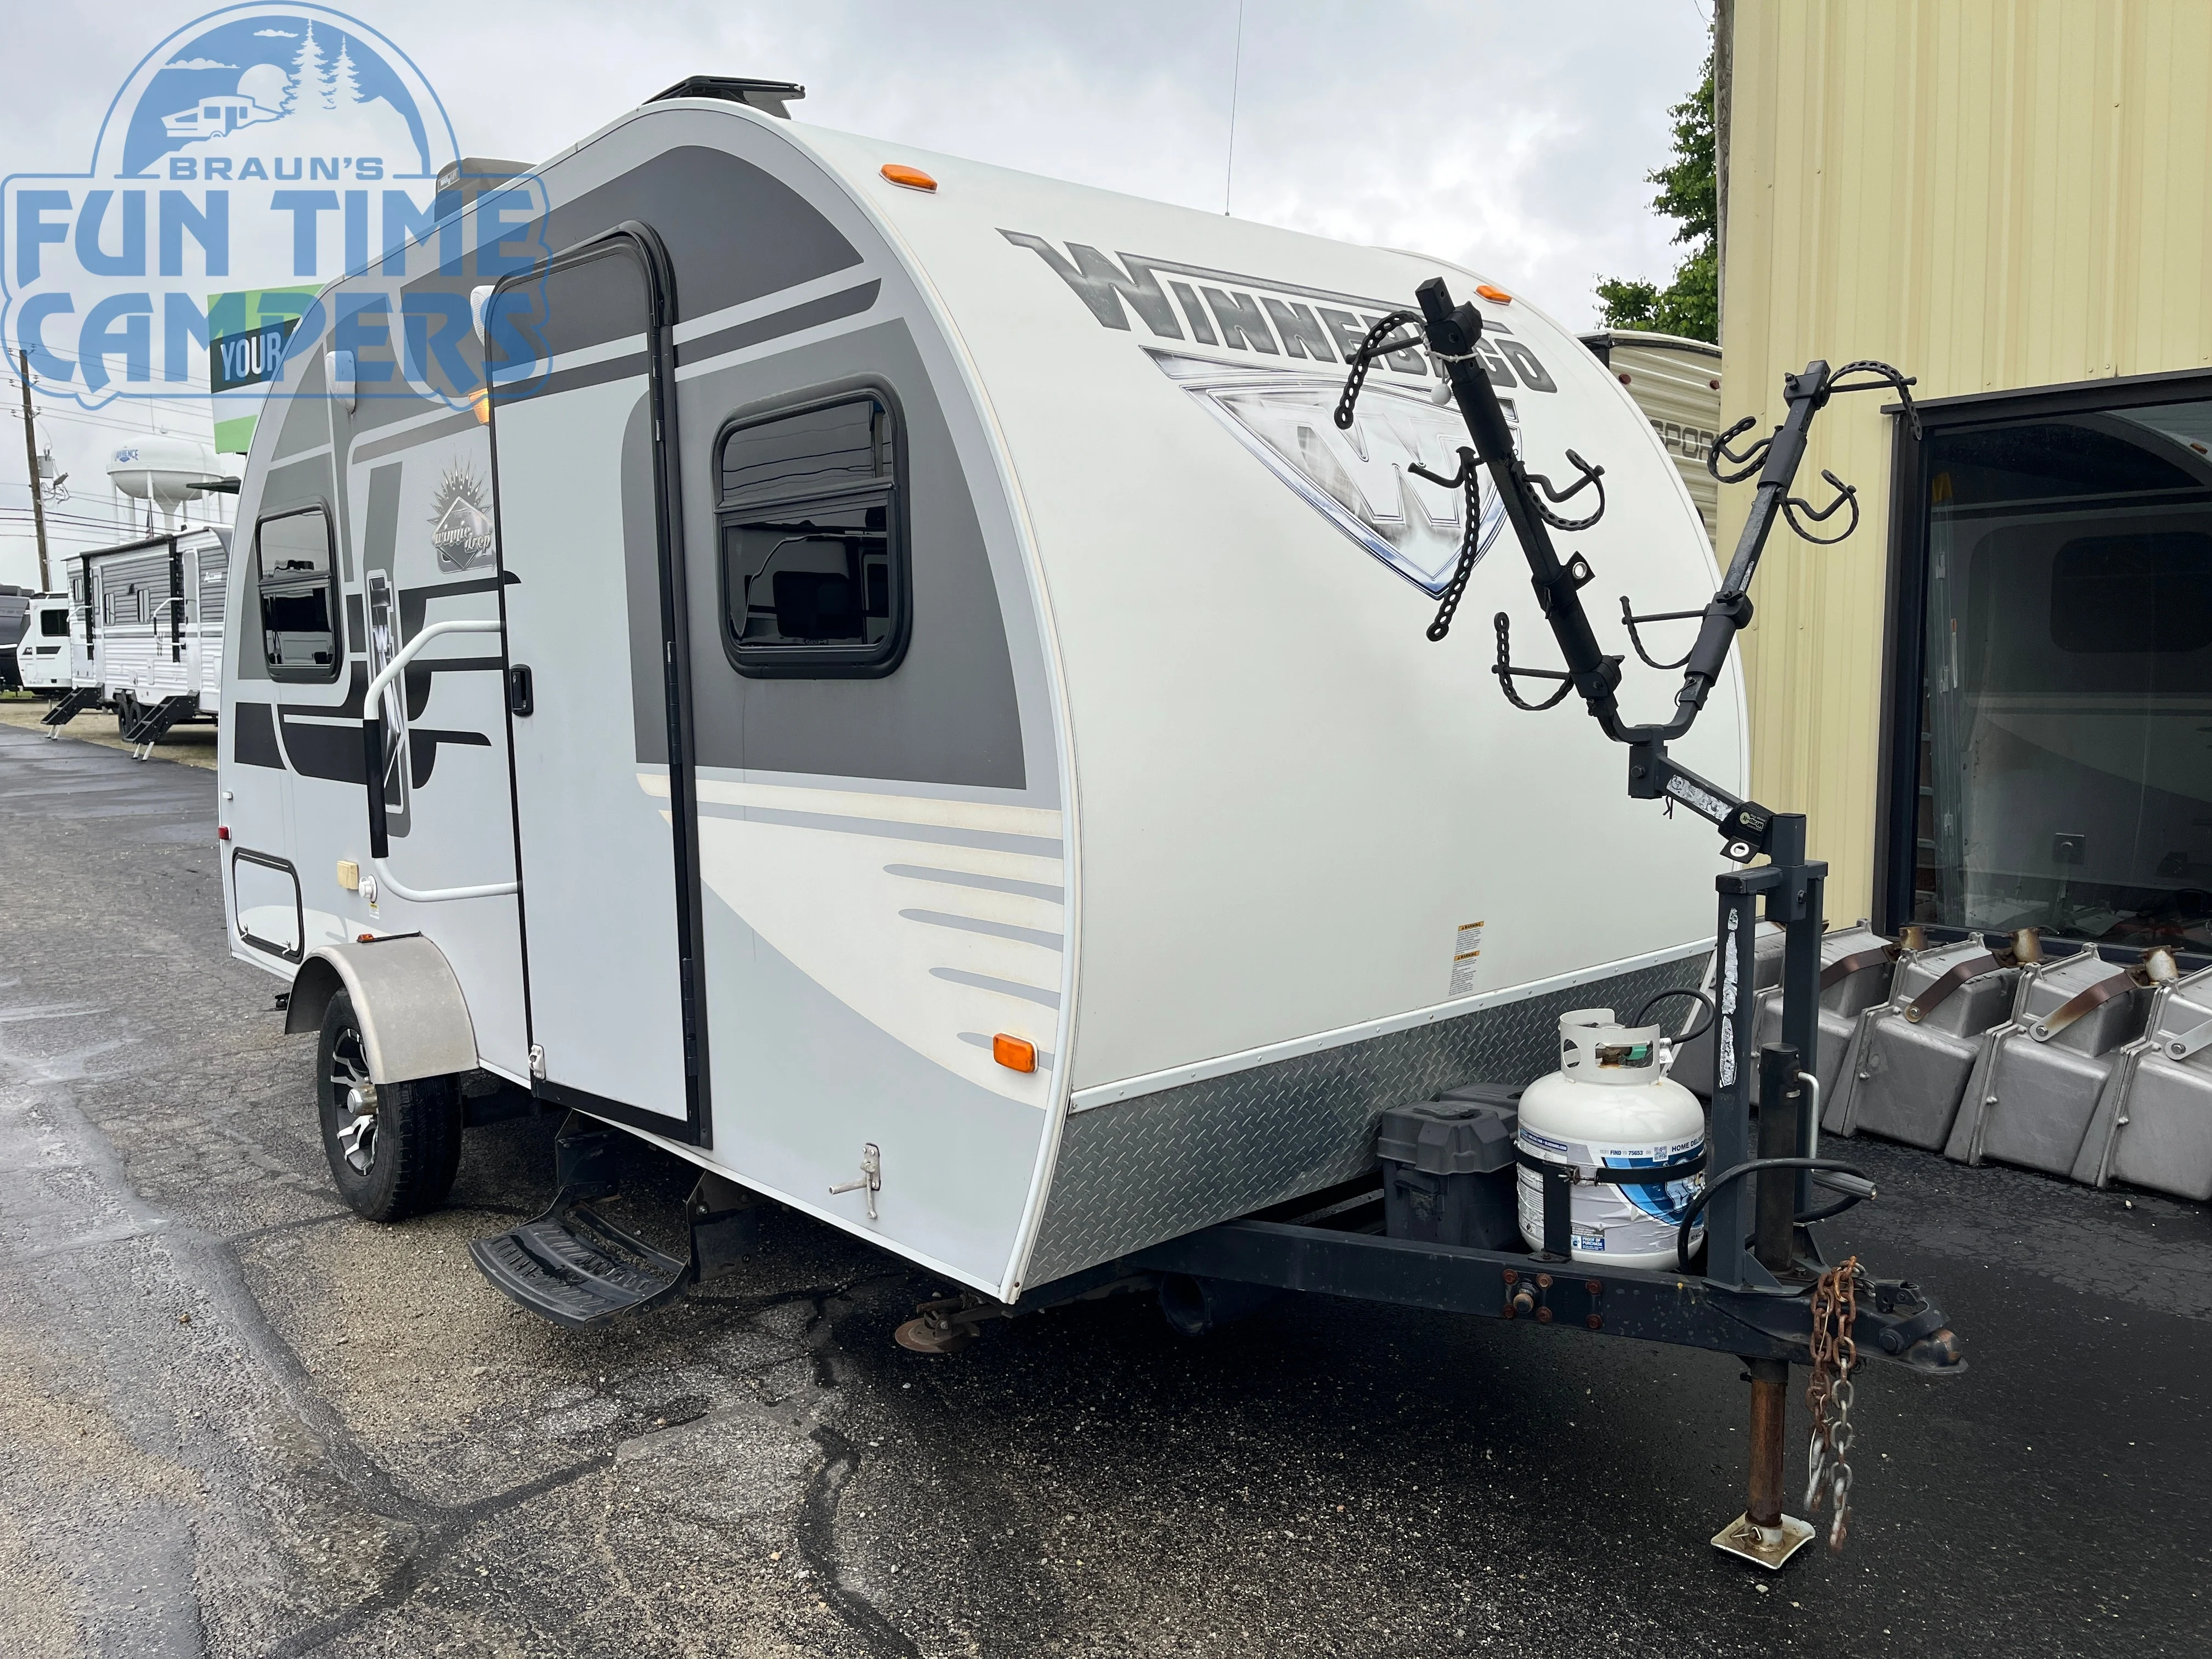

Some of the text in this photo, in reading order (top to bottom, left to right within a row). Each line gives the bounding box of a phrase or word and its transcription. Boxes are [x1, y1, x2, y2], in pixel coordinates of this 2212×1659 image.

[995, 227, 1558, 393] WINNEBGO
[220, 331, 281, 381] YOUR
[1672, 1142, 1689, 1152] HOME
